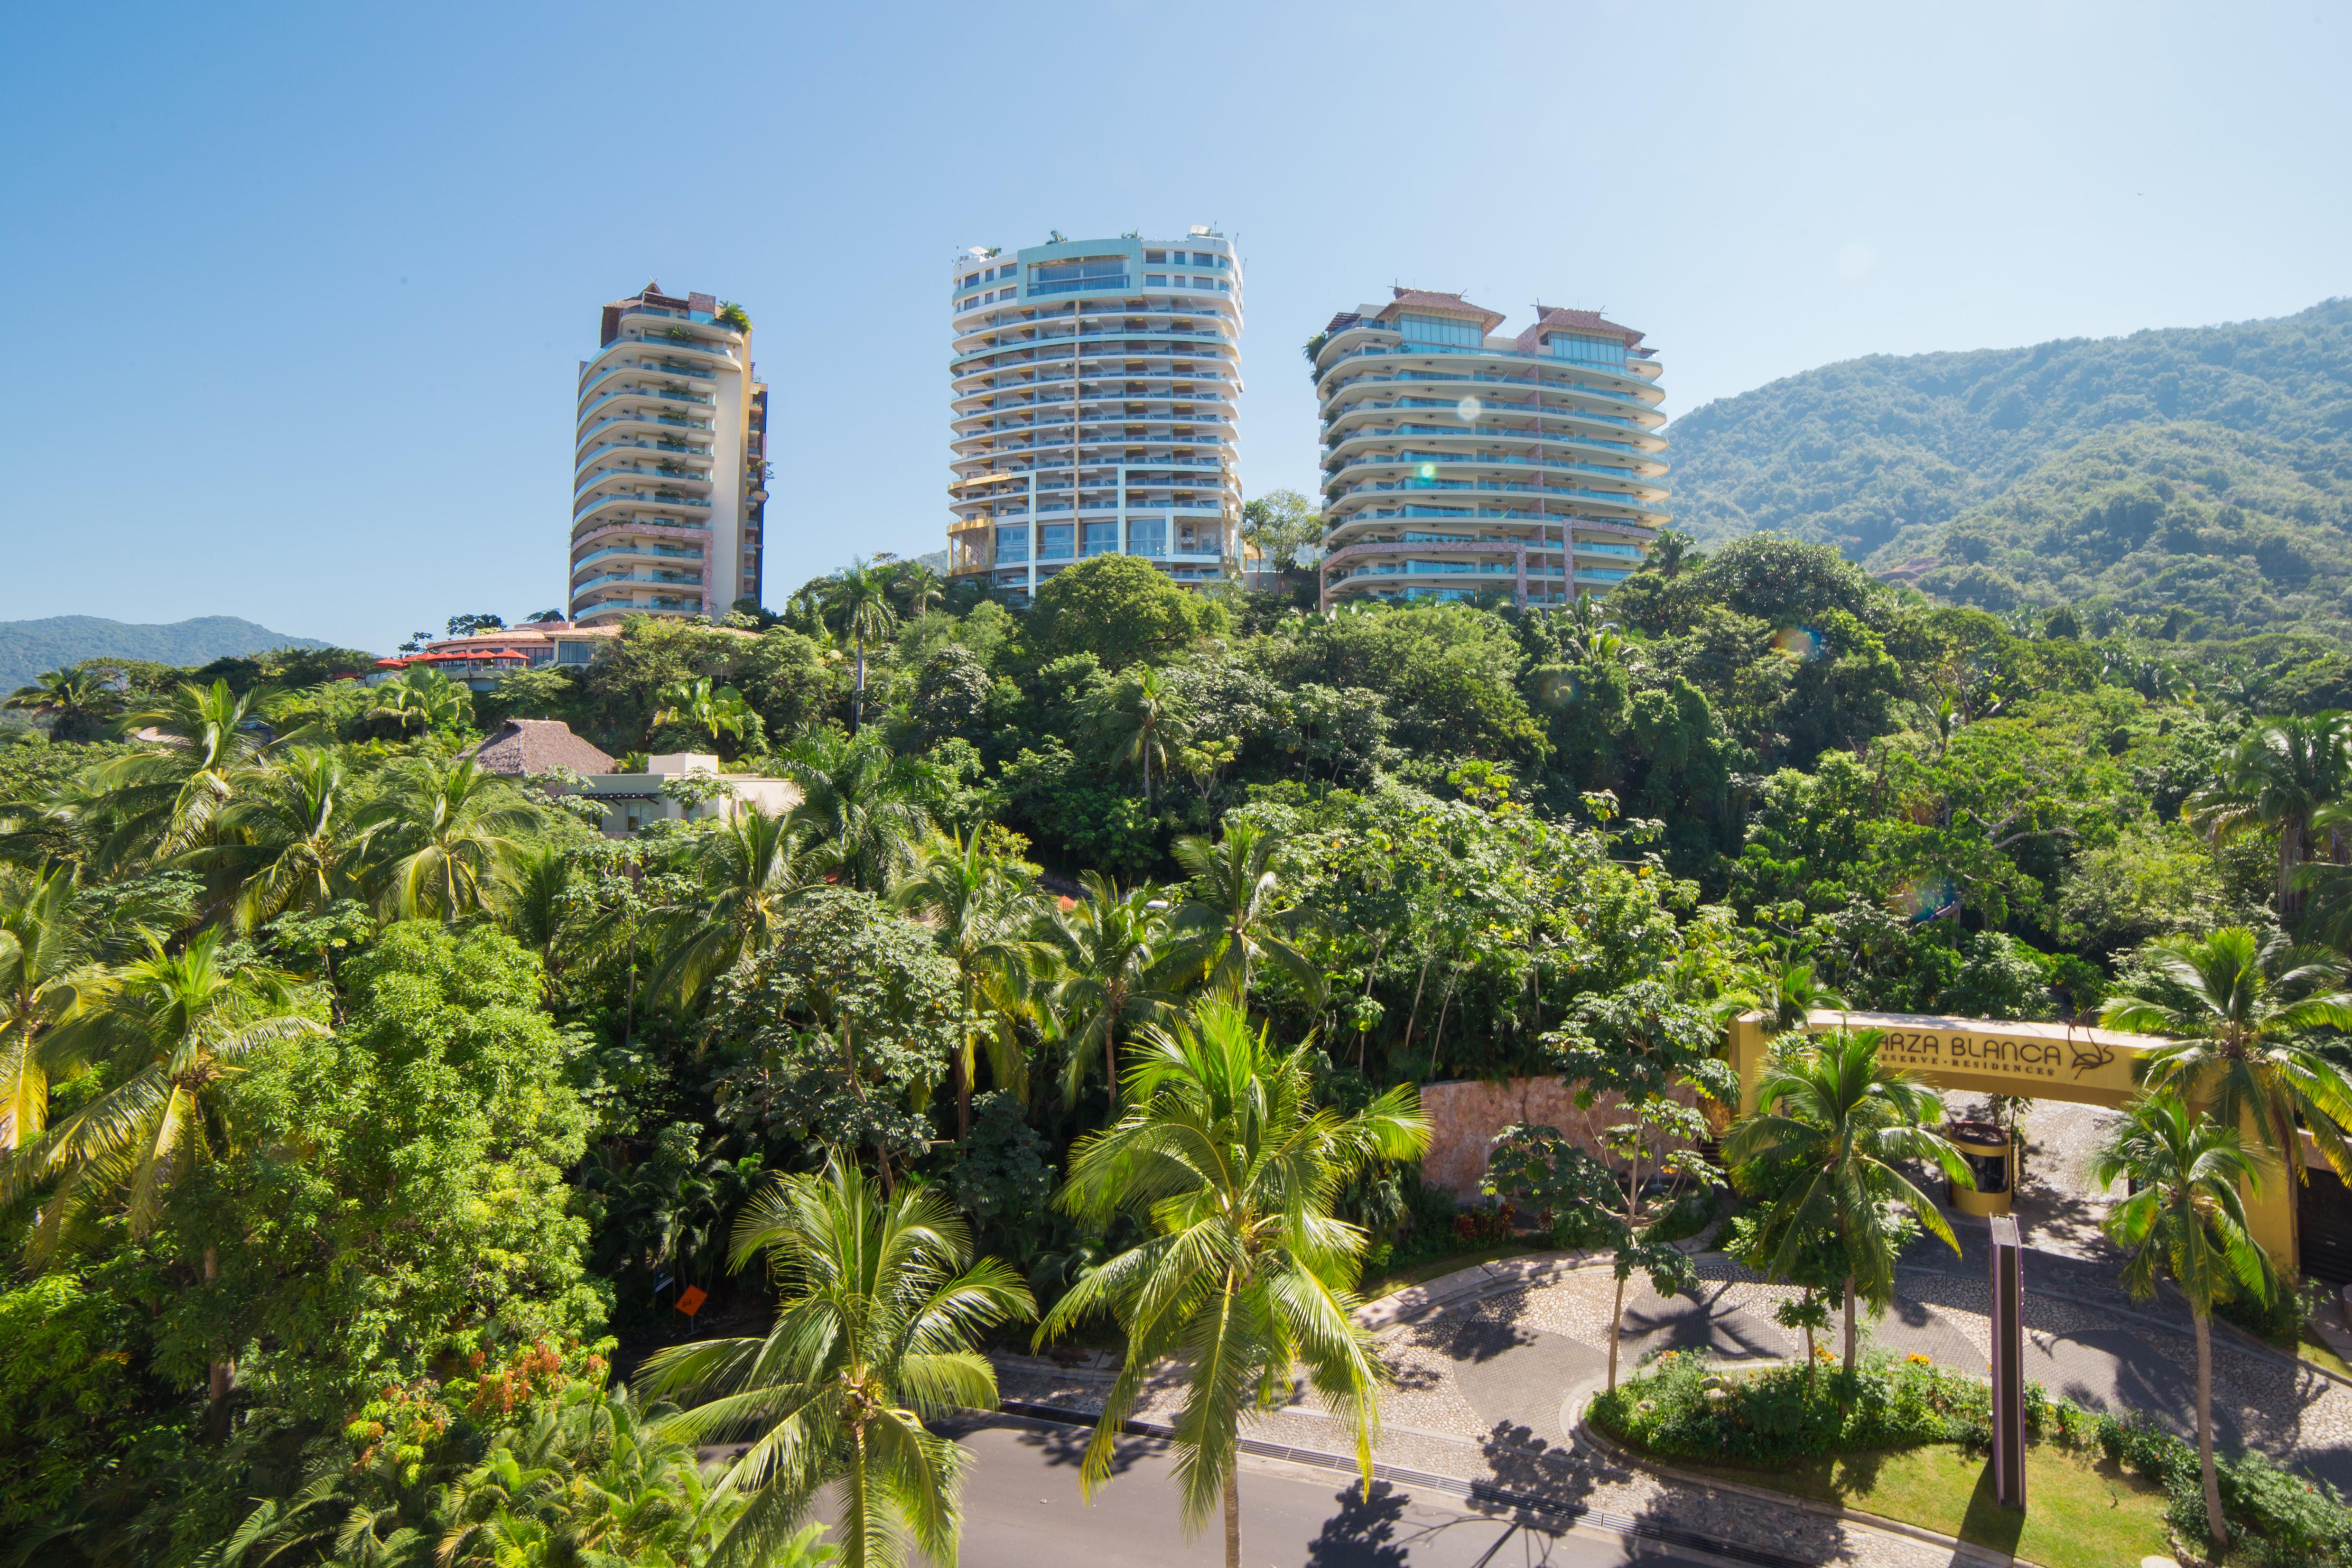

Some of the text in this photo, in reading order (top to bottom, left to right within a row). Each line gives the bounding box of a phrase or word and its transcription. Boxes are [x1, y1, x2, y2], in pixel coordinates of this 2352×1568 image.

[1952, 1037, 2061, 1066] BLANCA
[1880, 1054, 2055, 1076] ESERVE RESIDENCES
